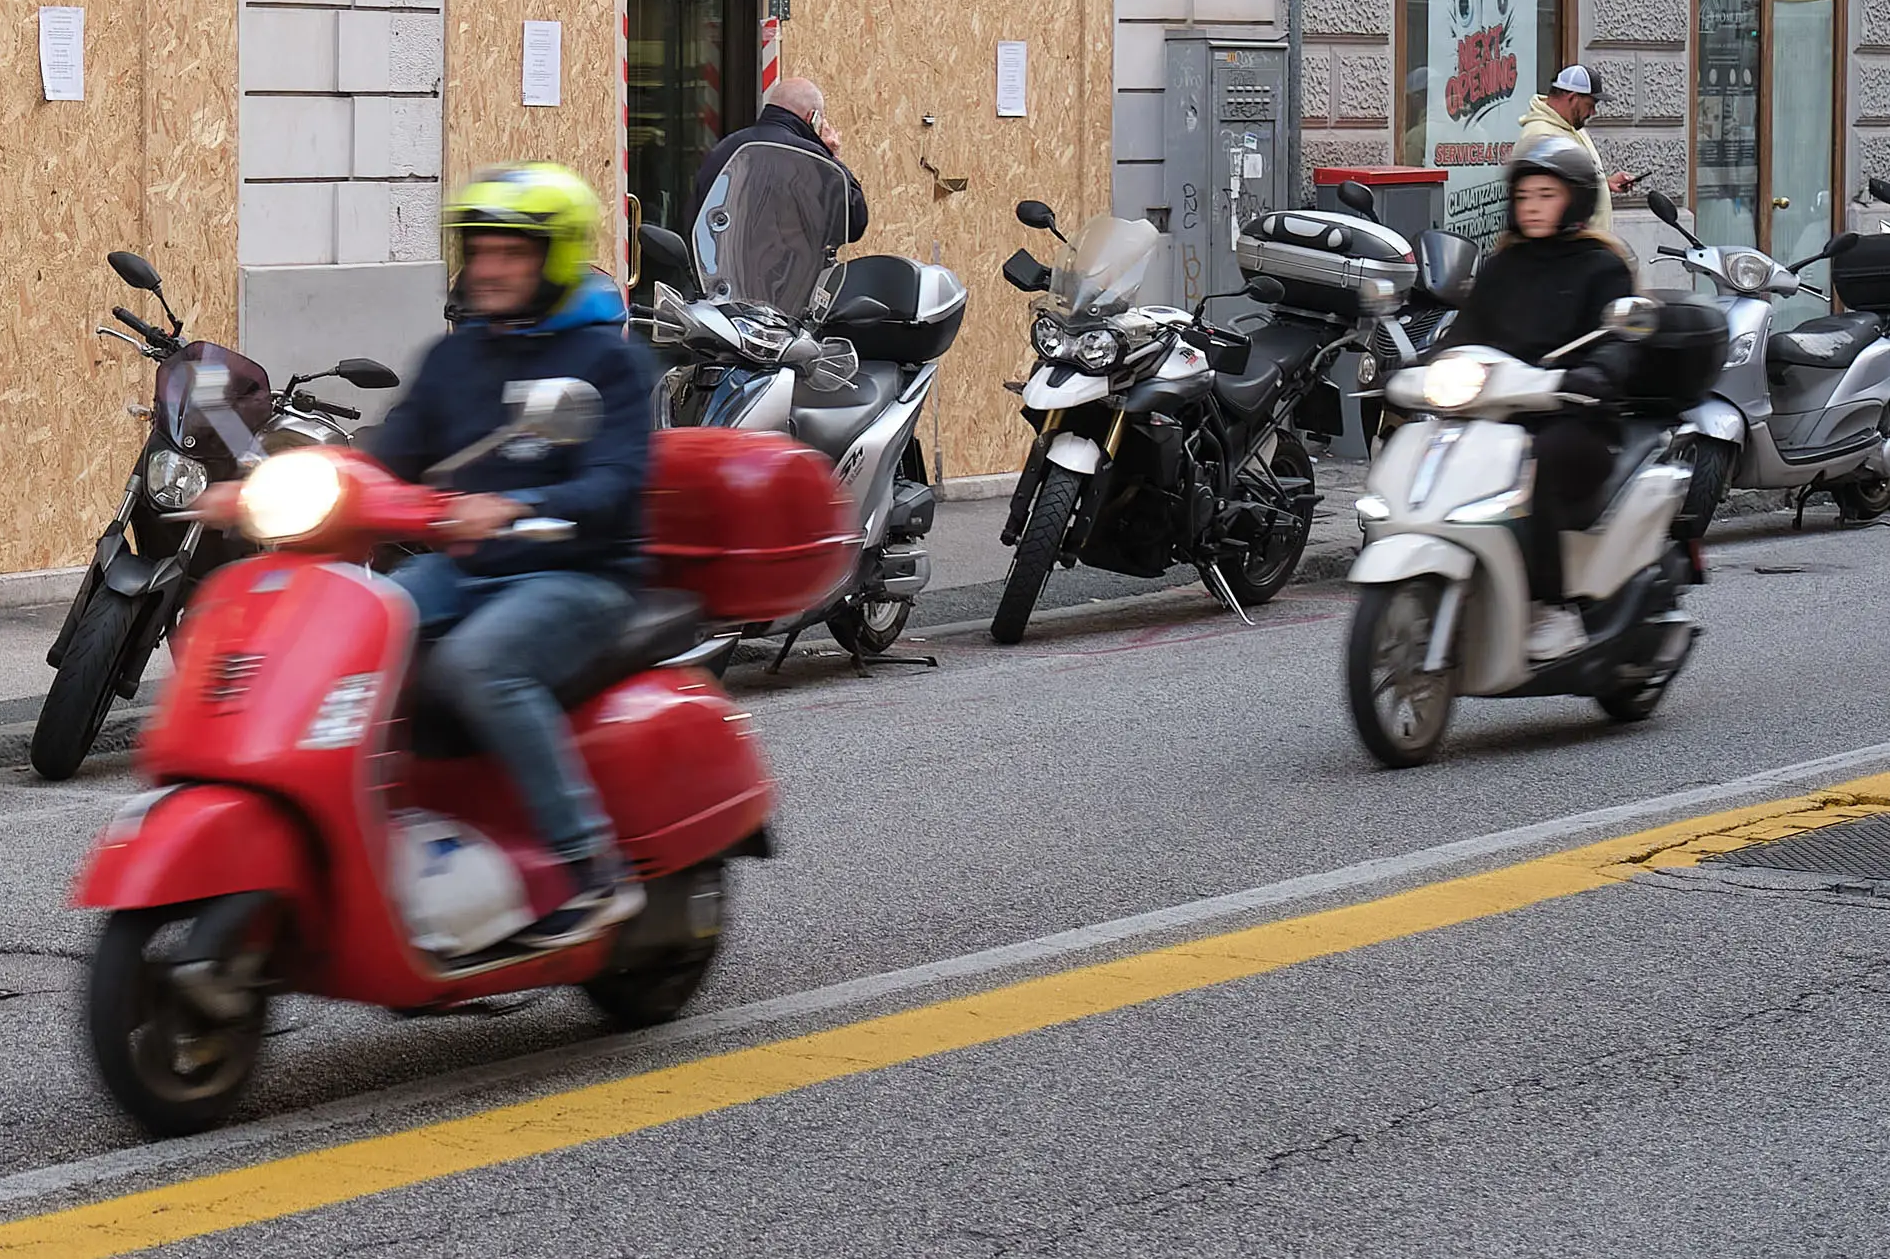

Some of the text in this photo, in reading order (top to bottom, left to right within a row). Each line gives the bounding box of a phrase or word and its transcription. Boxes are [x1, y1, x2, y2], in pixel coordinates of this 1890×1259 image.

[1457, 23, 1503, 74] NEXT
[1445, 53, 1517, 118] OPENING
[1435, 143, 1485, 166] SERVICE
[1447, 180, 1510, 217] CLIMATIZZATOR
